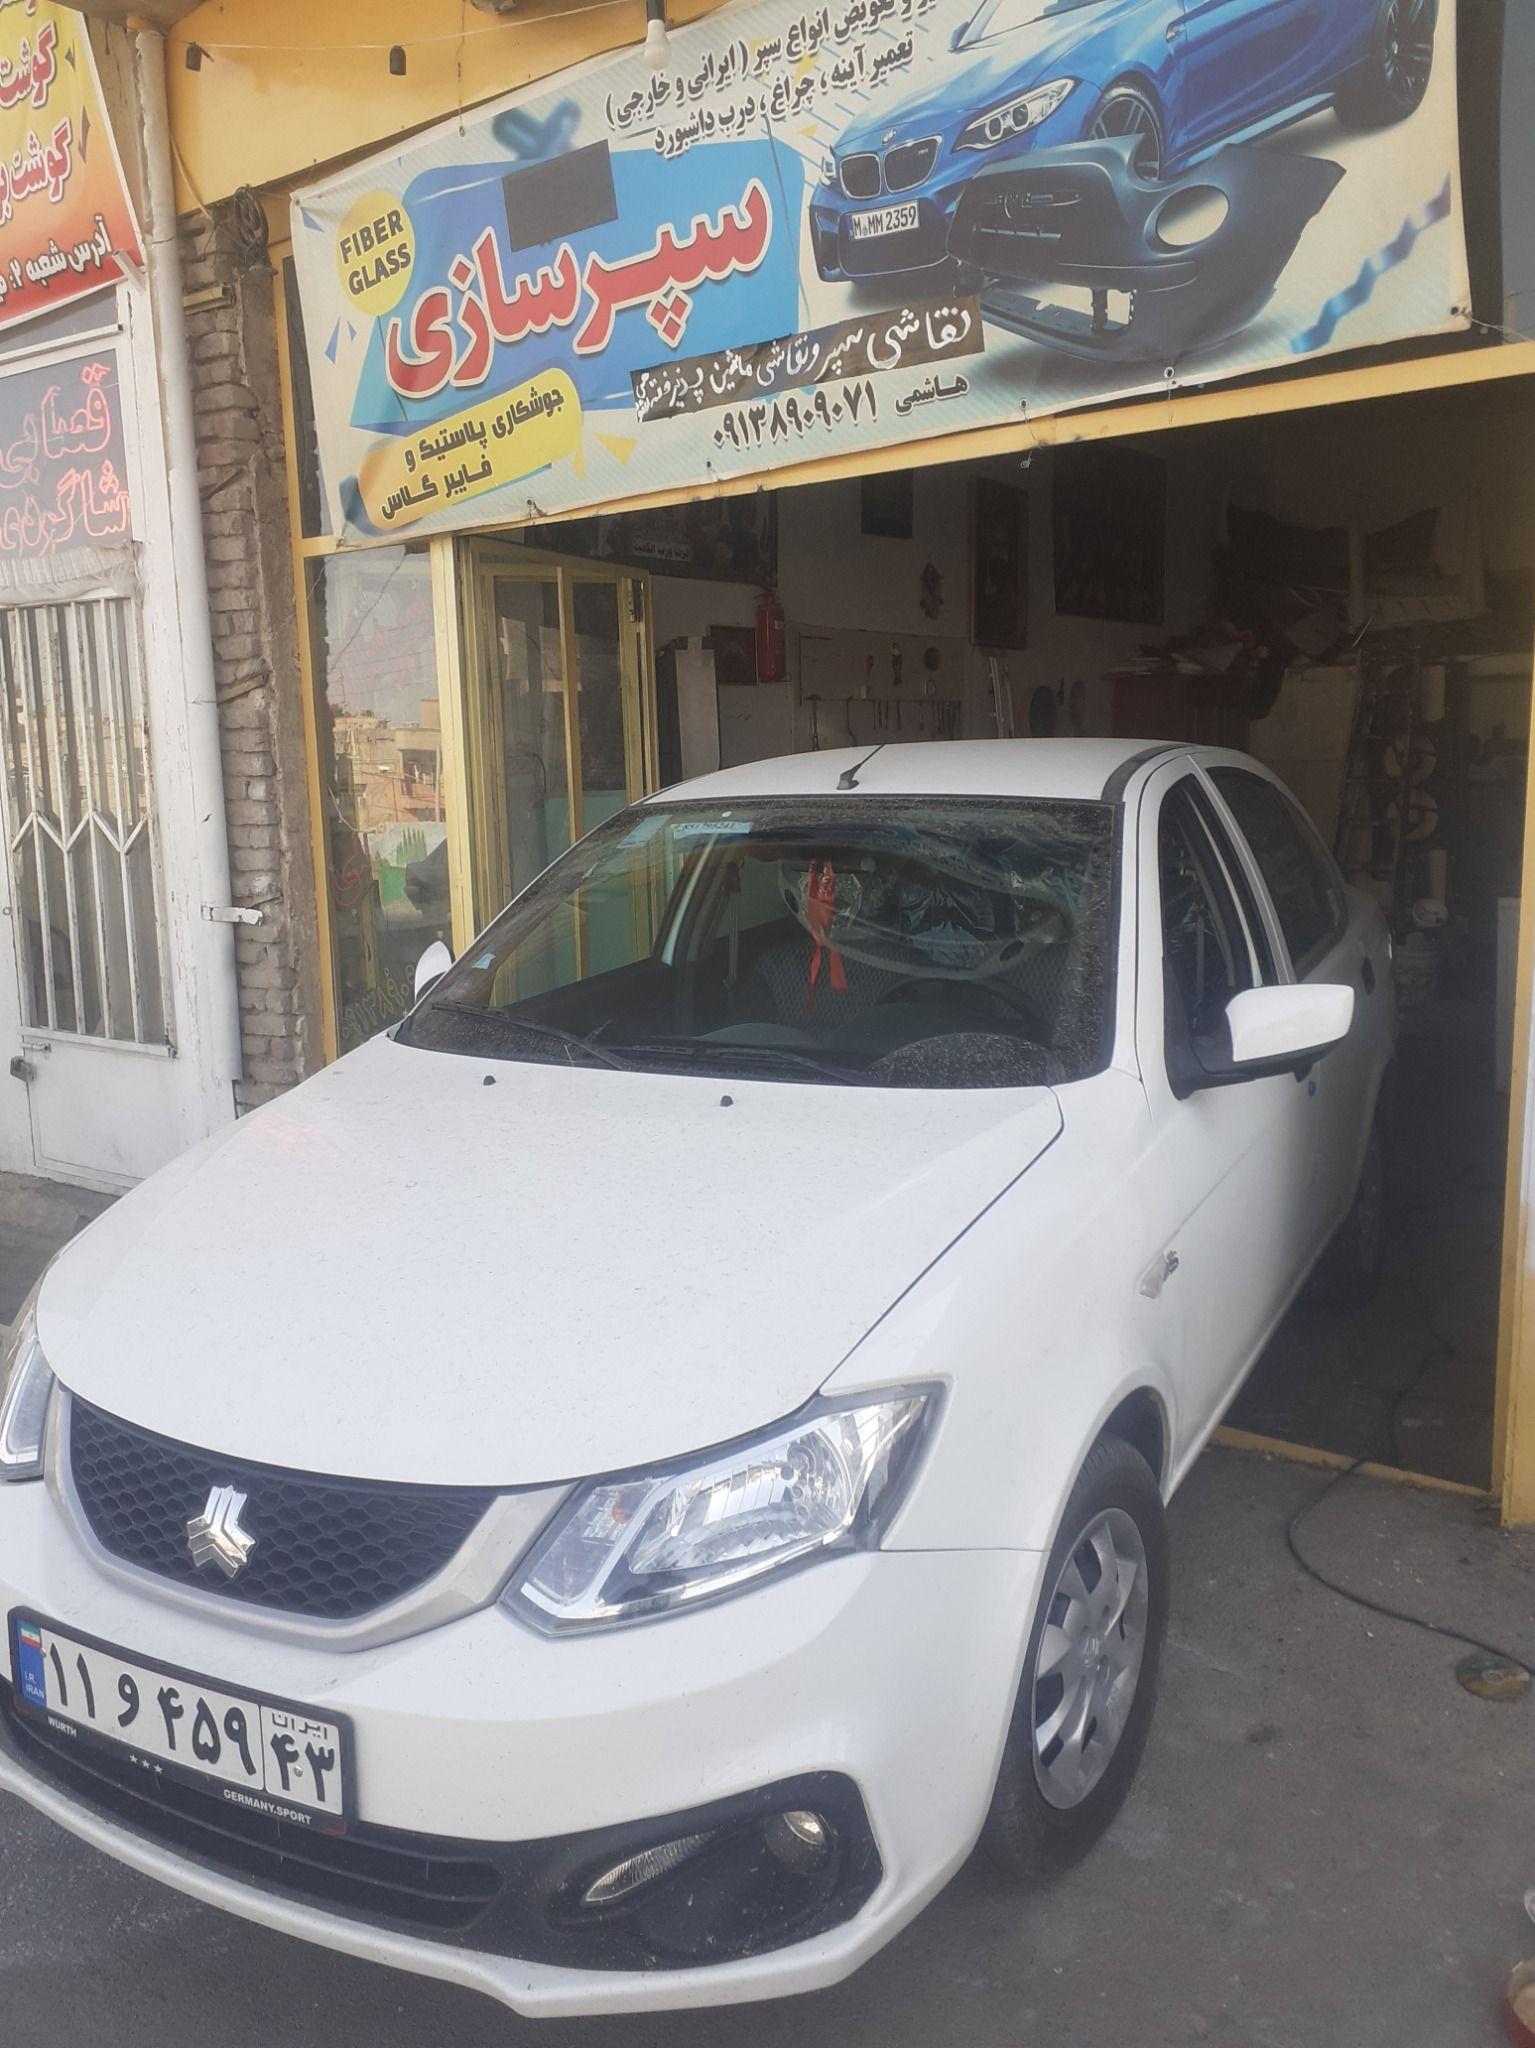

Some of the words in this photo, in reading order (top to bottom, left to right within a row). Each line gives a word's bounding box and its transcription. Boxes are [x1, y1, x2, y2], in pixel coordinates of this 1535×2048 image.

[754, 38, 782, 71] سپر
[786, 7, 829, 57] انواع
[869, 31, 913, 82] تعمیر
[676, 77, 685, 101] و
[655, 108, 715, 154] داشبورد
[718, 95, 755, 132] درب
[10, 118, 71, 202] گوشت
[68, 215, 112, 272] آدرس
[339, 209, 404, 264] FIBER
[25, 240, 67, 286] شعبه
[348, 243, 411, 295] GLASS
[814, 328, 863, 381] سپر
[866, 307, 972, 369] نقاشی
[650, 367, 704, 407] پذیرفته
[710, 350, 753, 394] ماشین
[896, 375, 968, 413] هاشمی
[491, 387, 564, 438] جوشکاری
[713, 380, 877, 447] ۰۹۱۳۸۹۰۹۰۷۱
[404, 449, 416, 473] و
[419, 420, 487, 461] پلاستیک
[444, 454, 493, 498] فایبر
[25, 1683, 45, 1700] IRAN
[47, 1716, 77, 1738] WURTH
[272, 1712, 328, 1741] ایران
